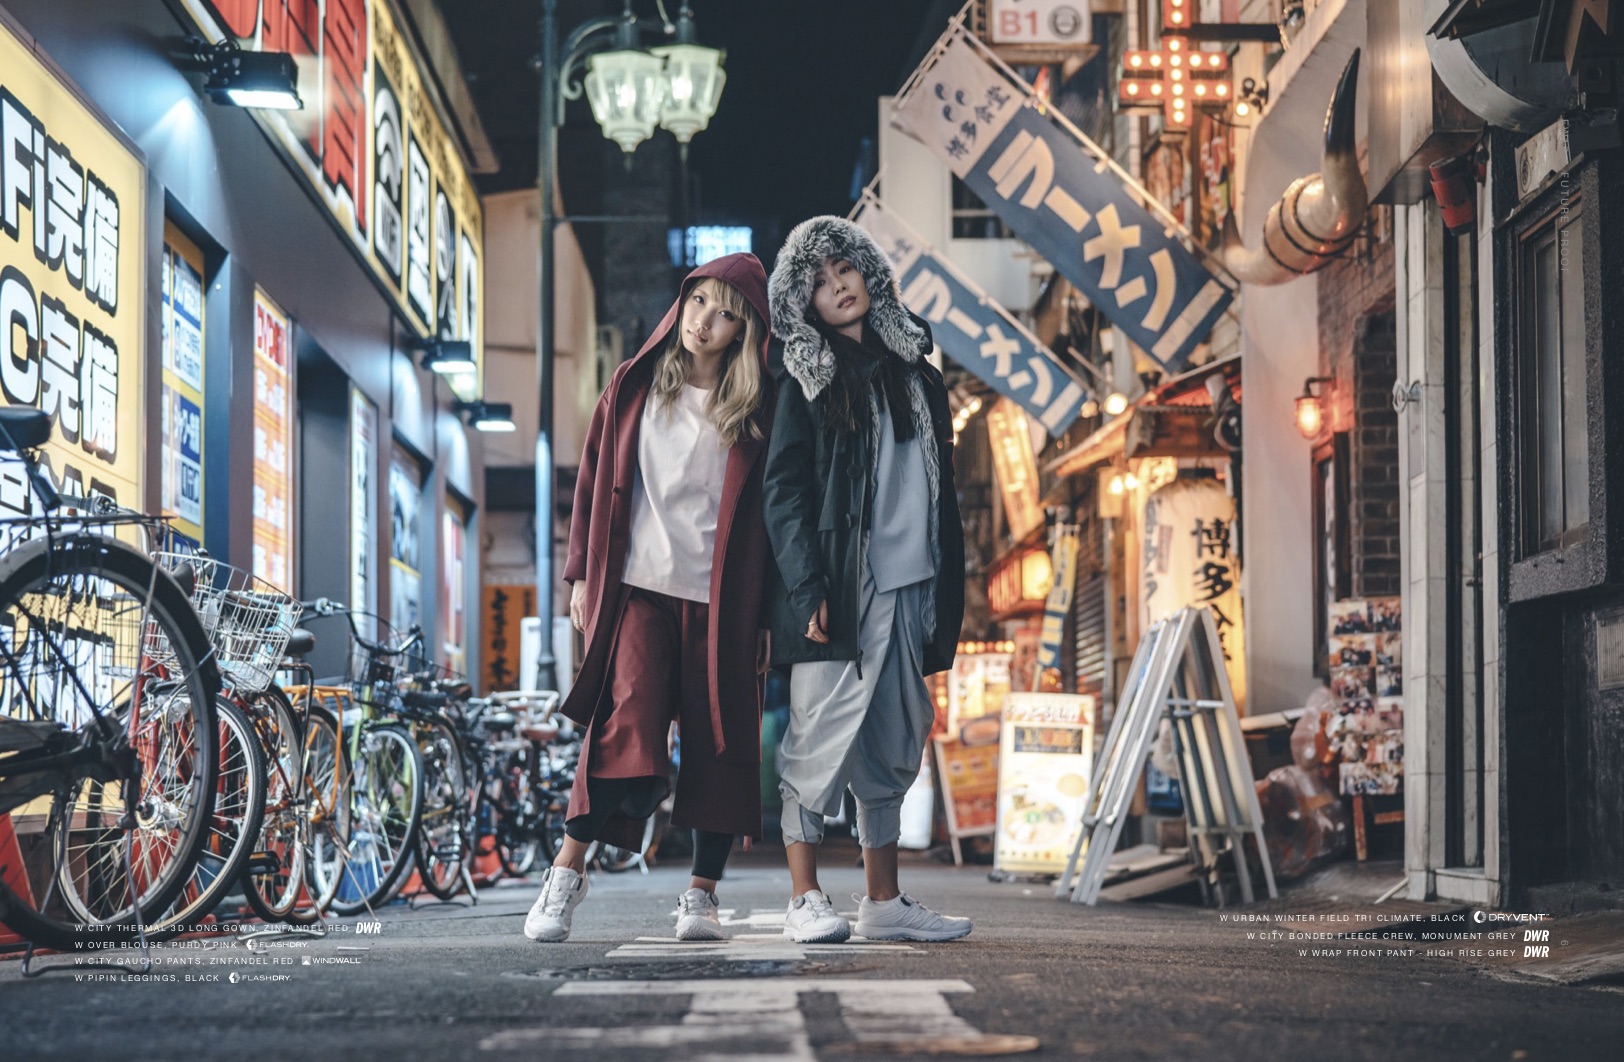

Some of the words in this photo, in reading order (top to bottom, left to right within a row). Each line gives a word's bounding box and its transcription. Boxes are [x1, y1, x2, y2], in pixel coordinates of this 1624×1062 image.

[1000, 9, 1038, 36] B1
[987, 129, 1177, 333] ラーメン
[902, 267, 1054, 408] ラーメン
